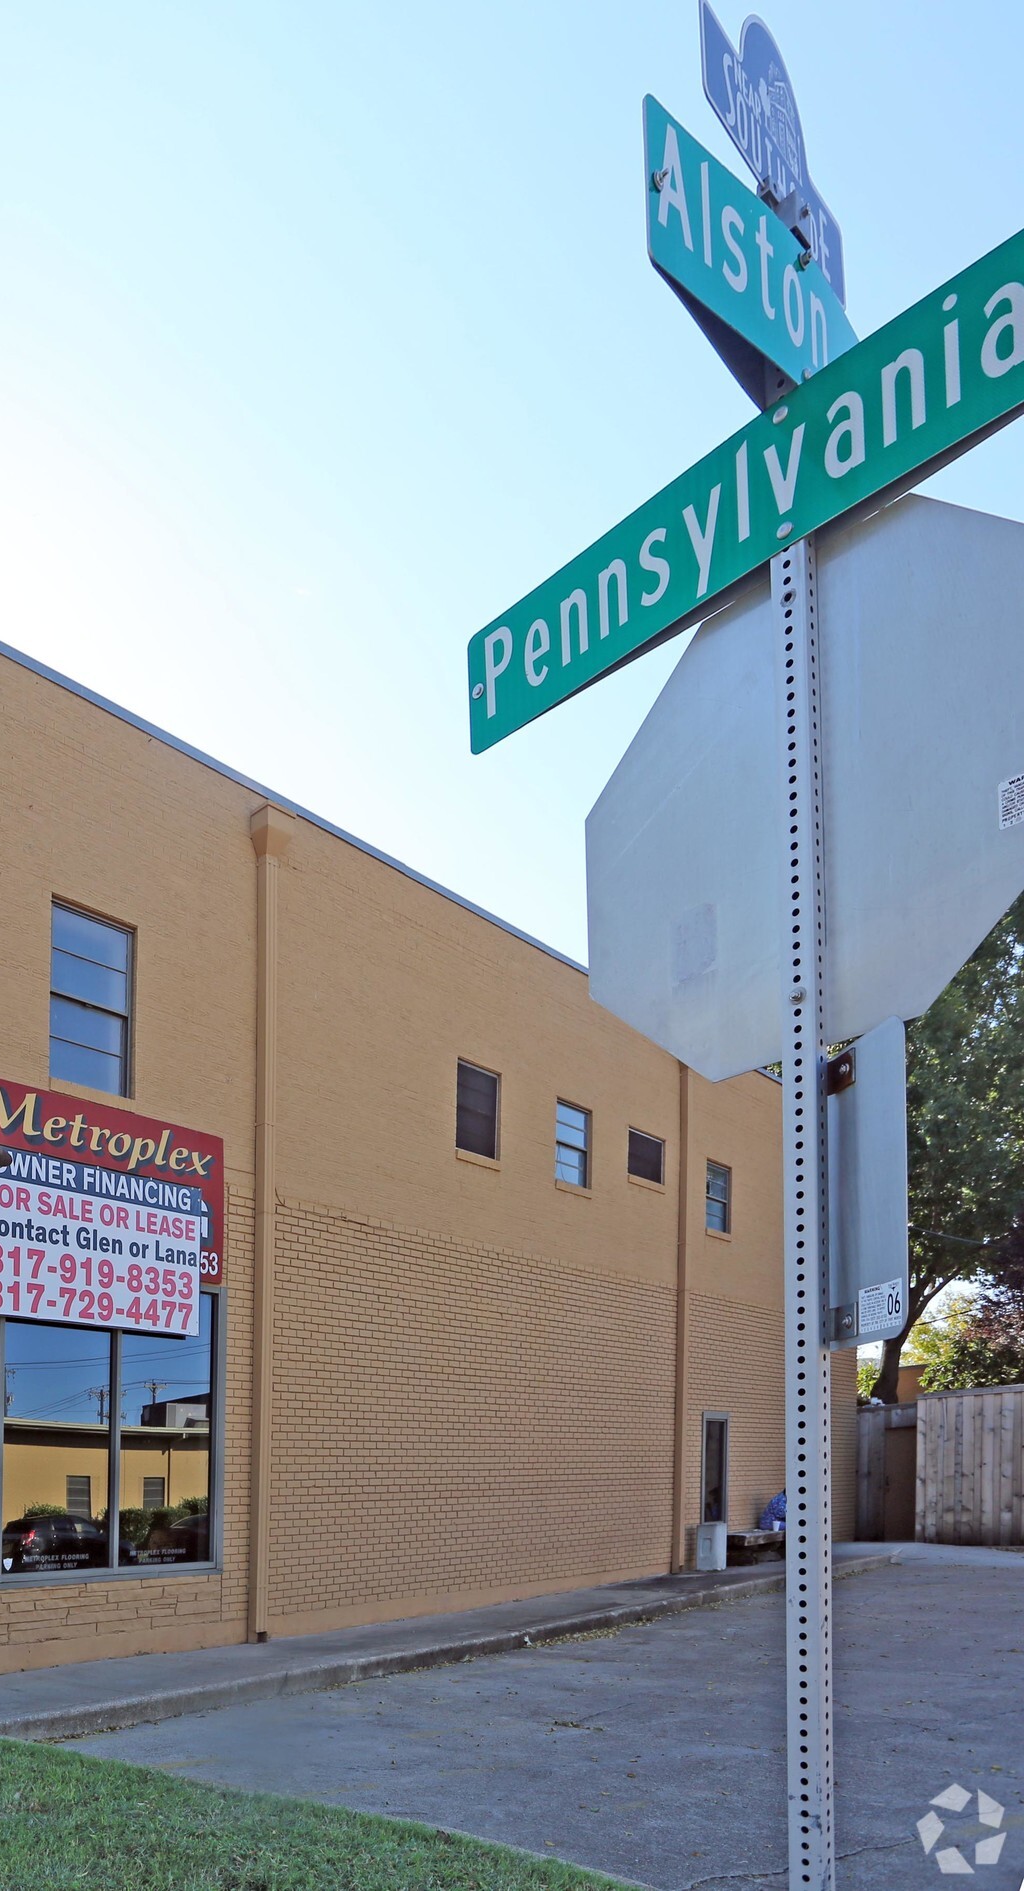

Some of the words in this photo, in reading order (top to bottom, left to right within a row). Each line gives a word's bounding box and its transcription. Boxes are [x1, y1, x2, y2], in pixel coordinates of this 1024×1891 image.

[722, 52, 832, 284] SOUTHDE
[657, 122, 828, 369] Alston
[484, 281, 1024, 719] Pennsylvania
[83, 1167, 191, 1211] FINANCING
[37, 1191, 94, 1224] SALE
[100, 1203, 129, 1230] OR
[136, 1210, 196, 1242] LEASE
[76, 1226, 123, 1256] Glen
[128, 1241, 149, 1259] or
[155, 1239, 198, 1268] Lana
[887, 1291, 901, 1316] 06
[24, 1554, 59, 1563] METROPLEX
[61, 1553, 90, 1561] FLOORING
[35, 1562, 61, 1570] PARKING
